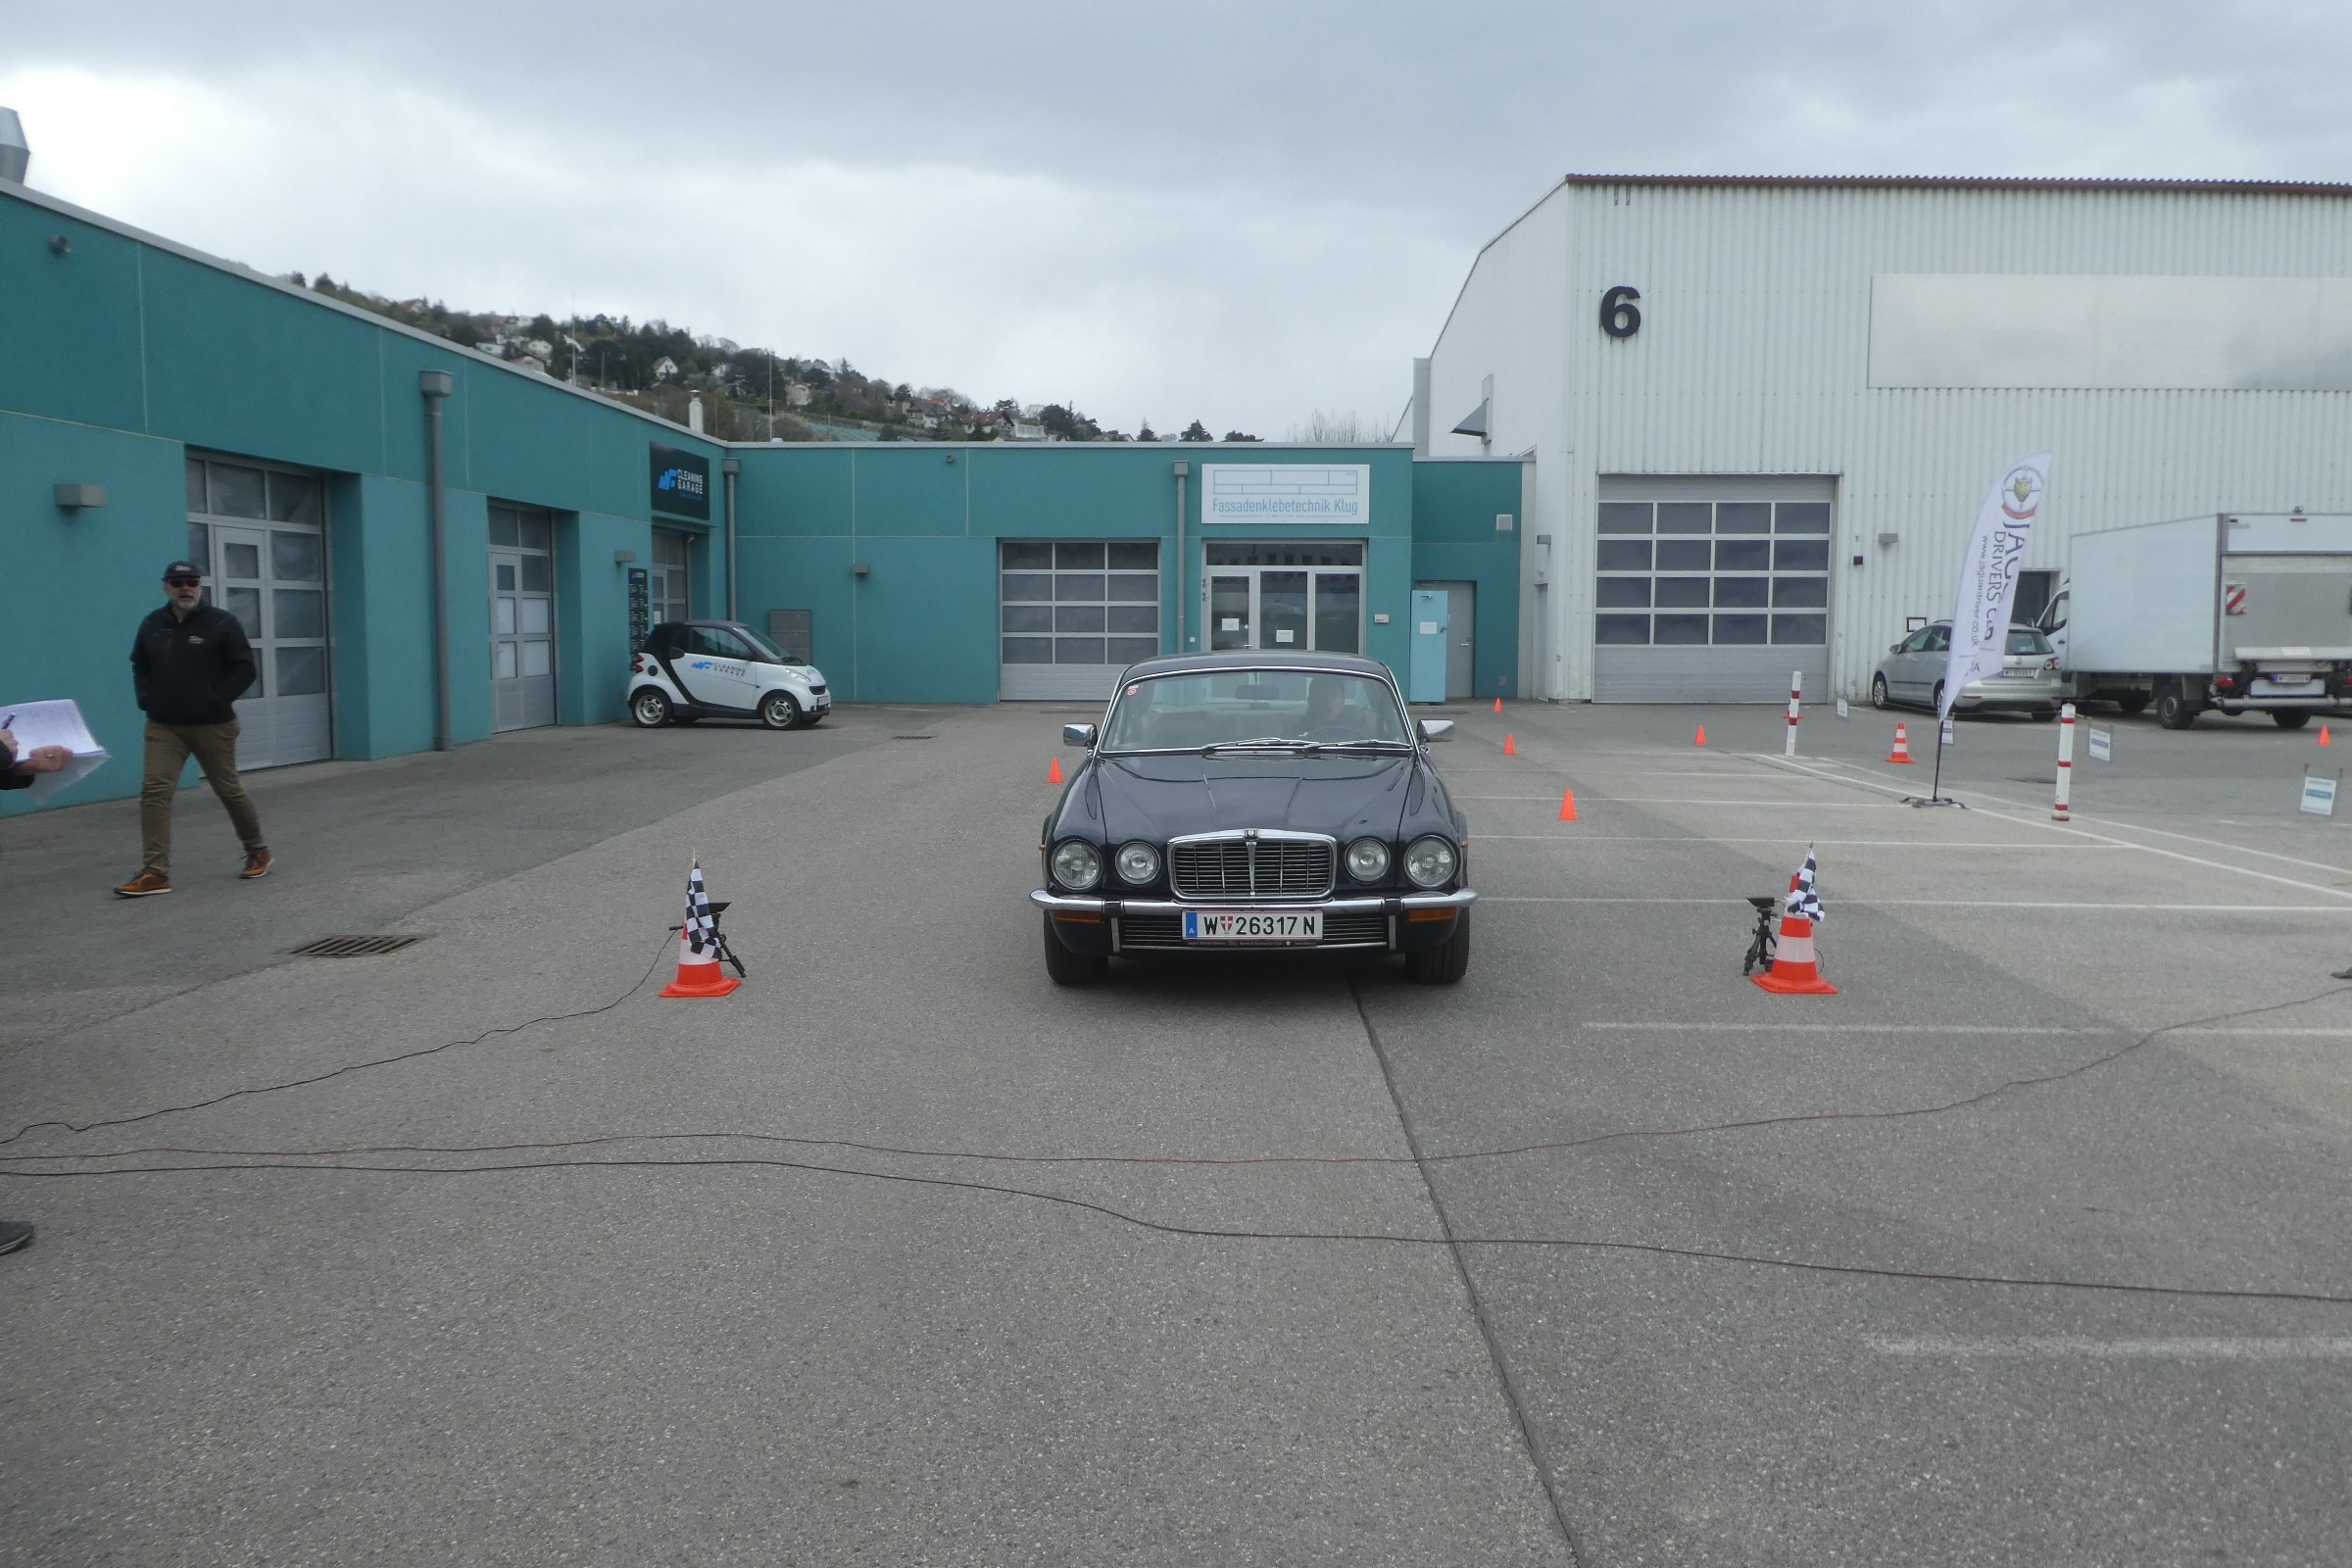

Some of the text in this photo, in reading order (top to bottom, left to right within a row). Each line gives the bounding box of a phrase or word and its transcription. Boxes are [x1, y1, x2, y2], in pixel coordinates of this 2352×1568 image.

[1600, 285, 1642, 338] 6
[677, 468, 704, 485] CLEANING
[677, 479, 704, 495] GARAGE
[1212, 498, 1358, 516] Fassadenklebetechnik Klug
[713, 666, 745, 677] GARAGE
[1203, 915, 1315, 935] W 26317 N
